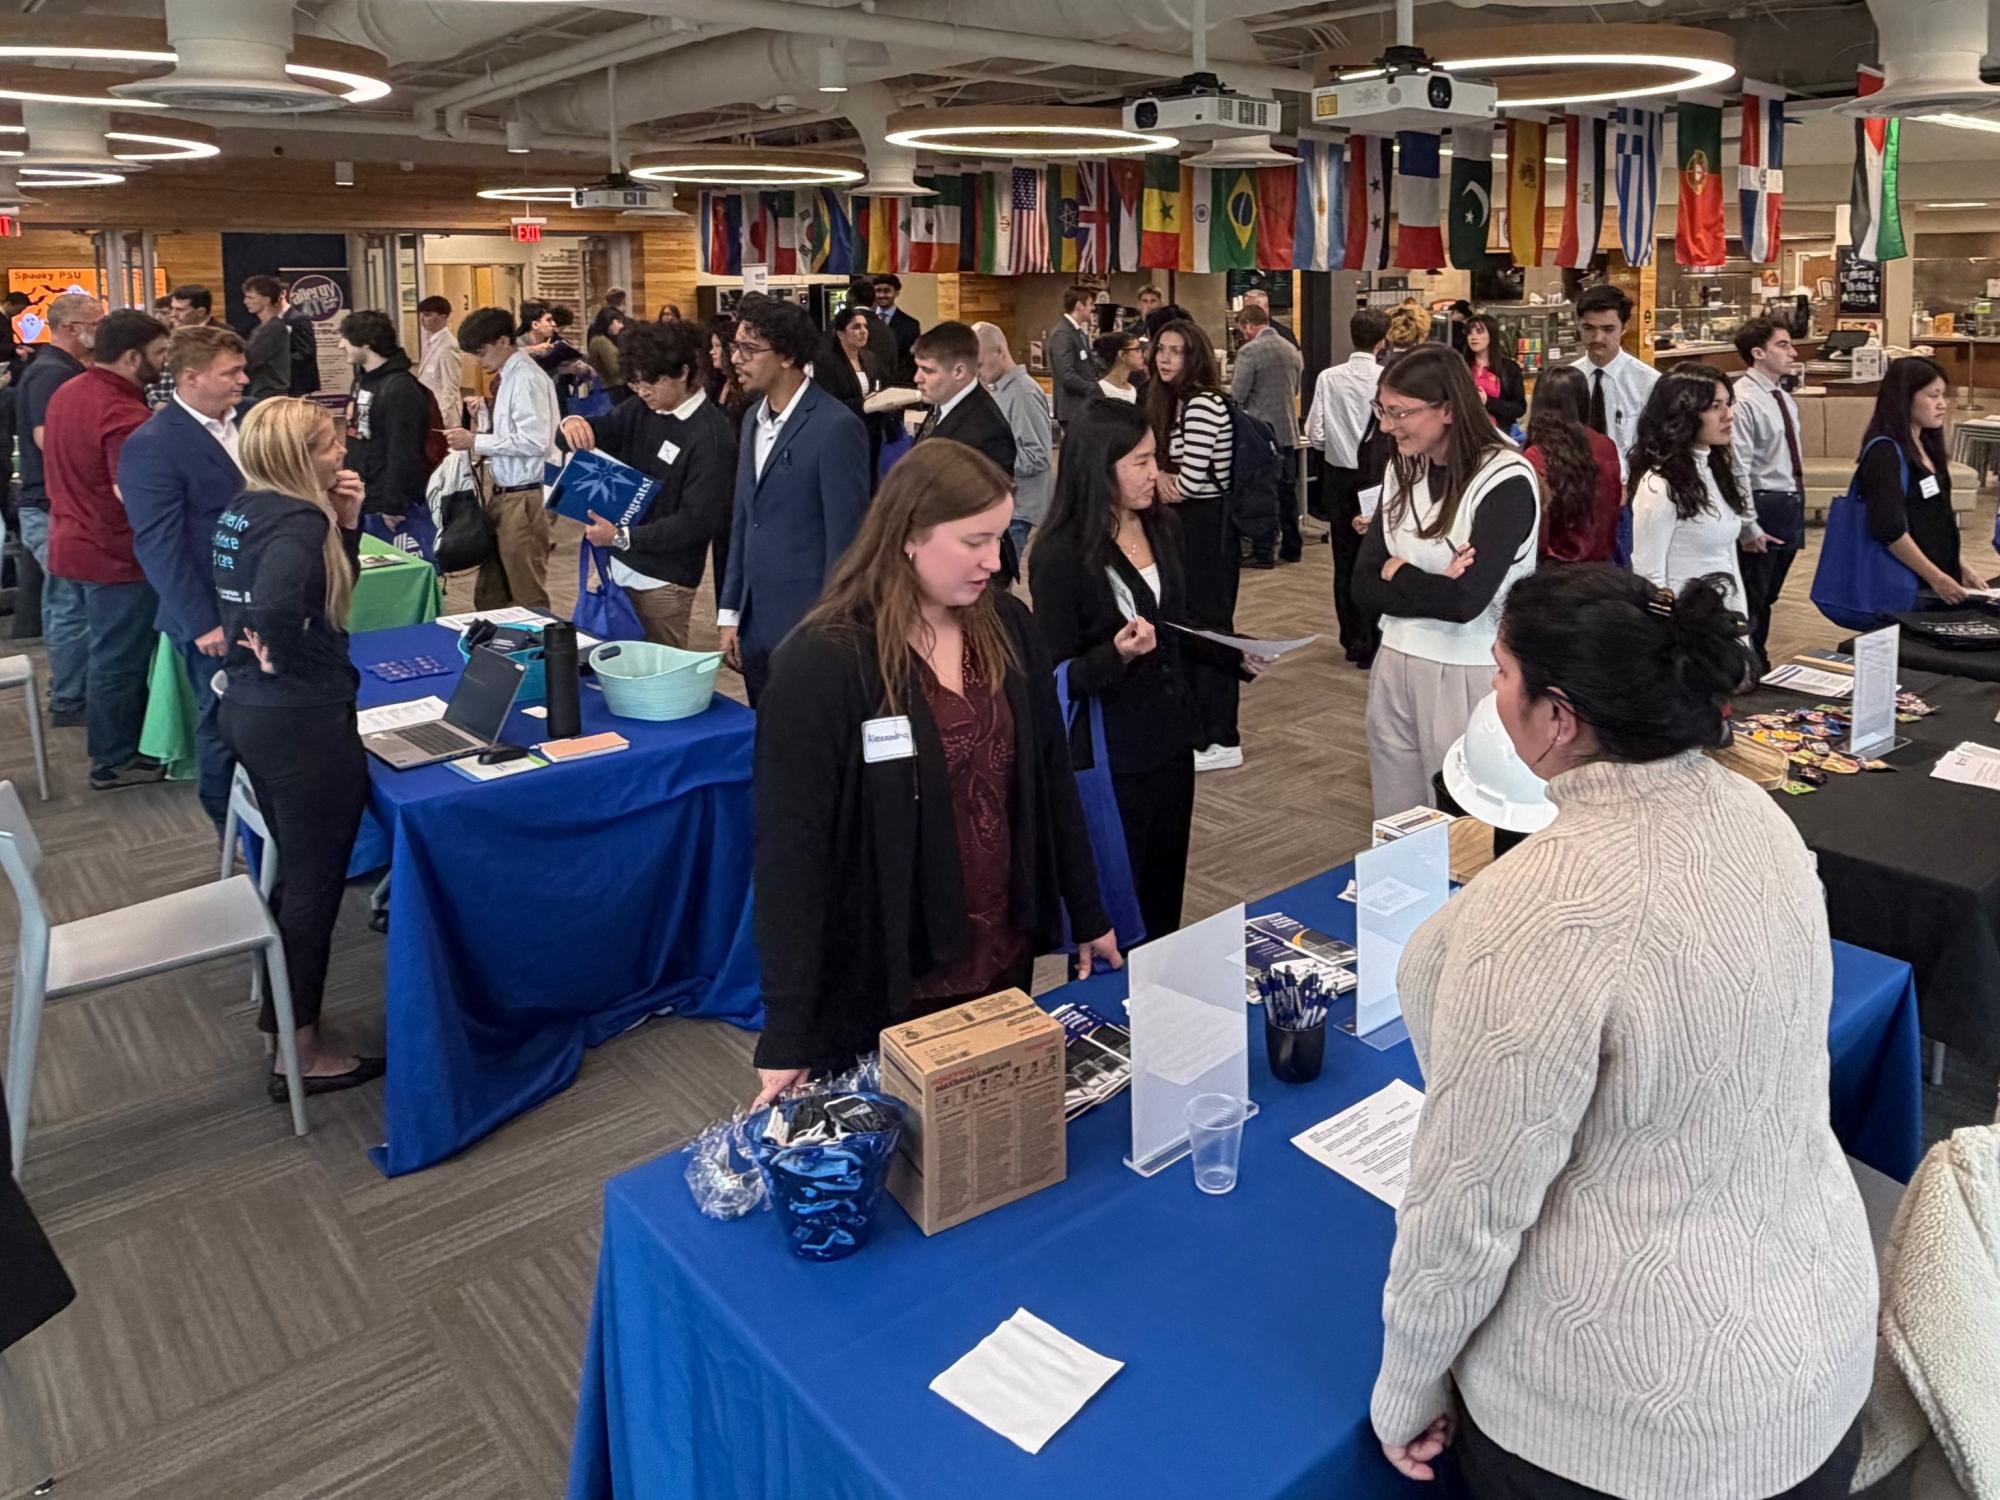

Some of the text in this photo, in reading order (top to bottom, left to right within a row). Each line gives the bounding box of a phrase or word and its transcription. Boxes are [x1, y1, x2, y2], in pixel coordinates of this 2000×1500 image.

[518, 224, 541, 242] EXIT
[59, 271, 81, 279] PSU
[291, 281, 335, 305] allergy
[615, 477, 653, 526] ongrats!
